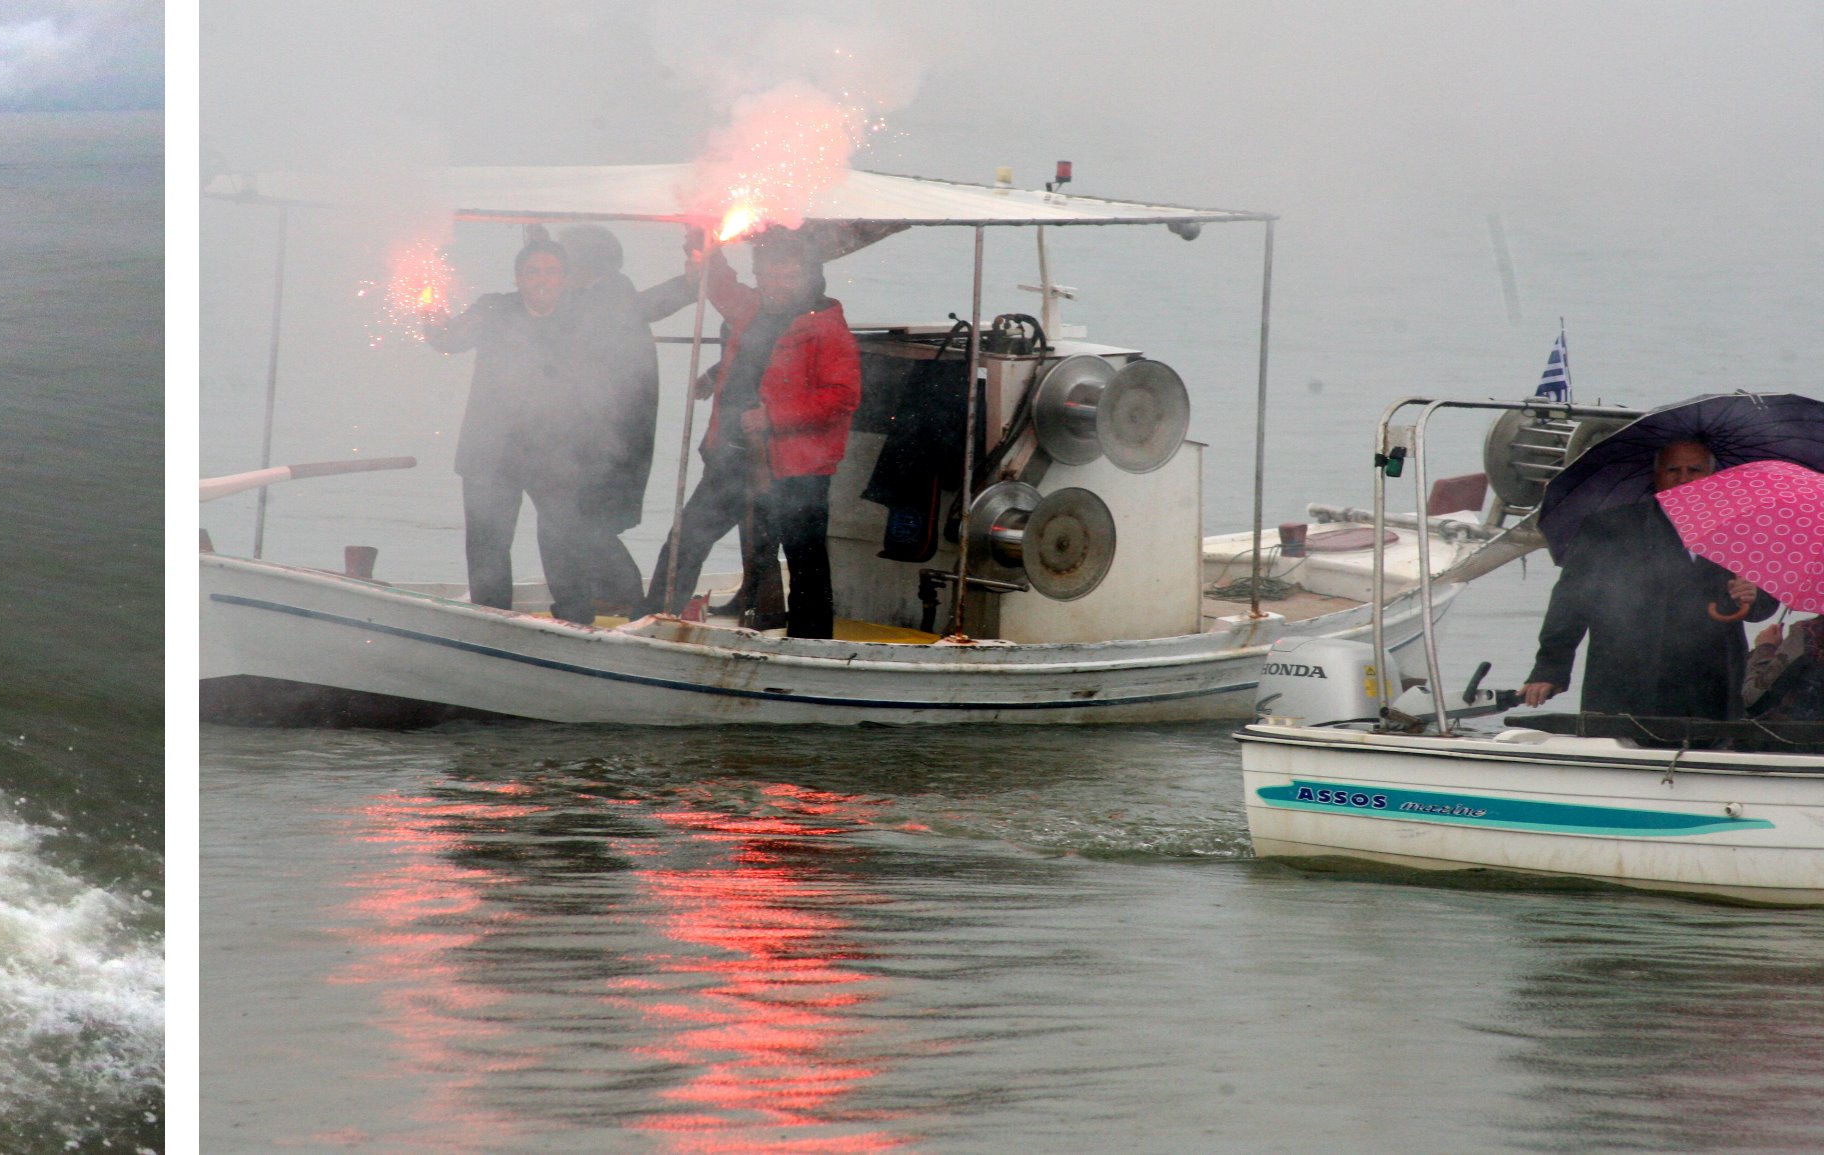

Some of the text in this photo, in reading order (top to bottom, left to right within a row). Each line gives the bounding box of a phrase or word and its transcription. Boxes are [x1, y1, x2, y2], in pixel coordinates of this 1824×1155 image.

[1261, 663, 1328, 679] HONDA
[1296, 786, 1486, 818] ASSOS marine
